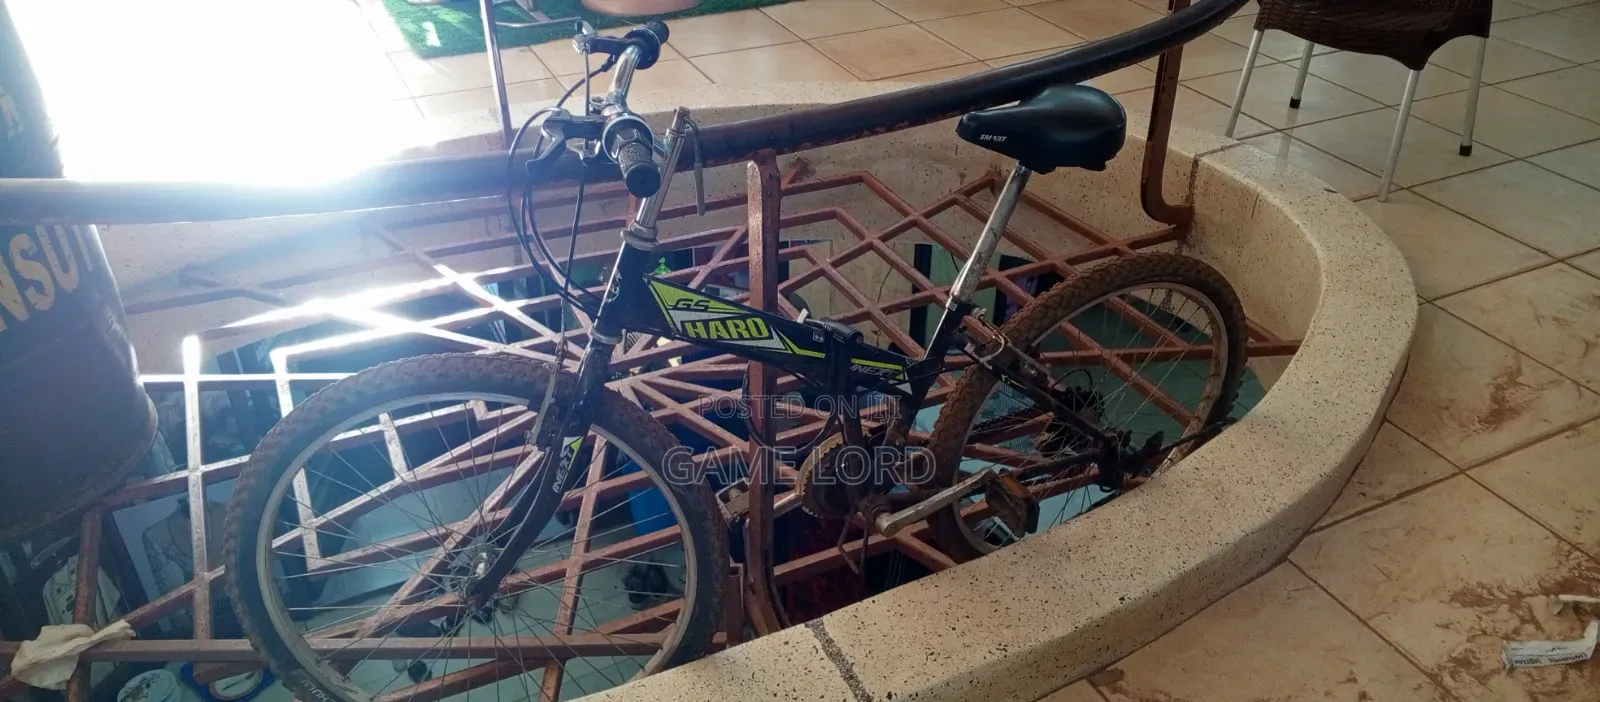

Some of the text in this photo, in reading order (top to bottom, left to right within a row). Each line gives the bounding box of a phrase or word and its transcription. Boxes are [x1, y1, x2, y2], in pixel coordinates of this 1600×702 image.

[979, 134, 1007, 142] SMART
[672, 298, 711, 312] GS
[684, 317, 769, 339] HARO
